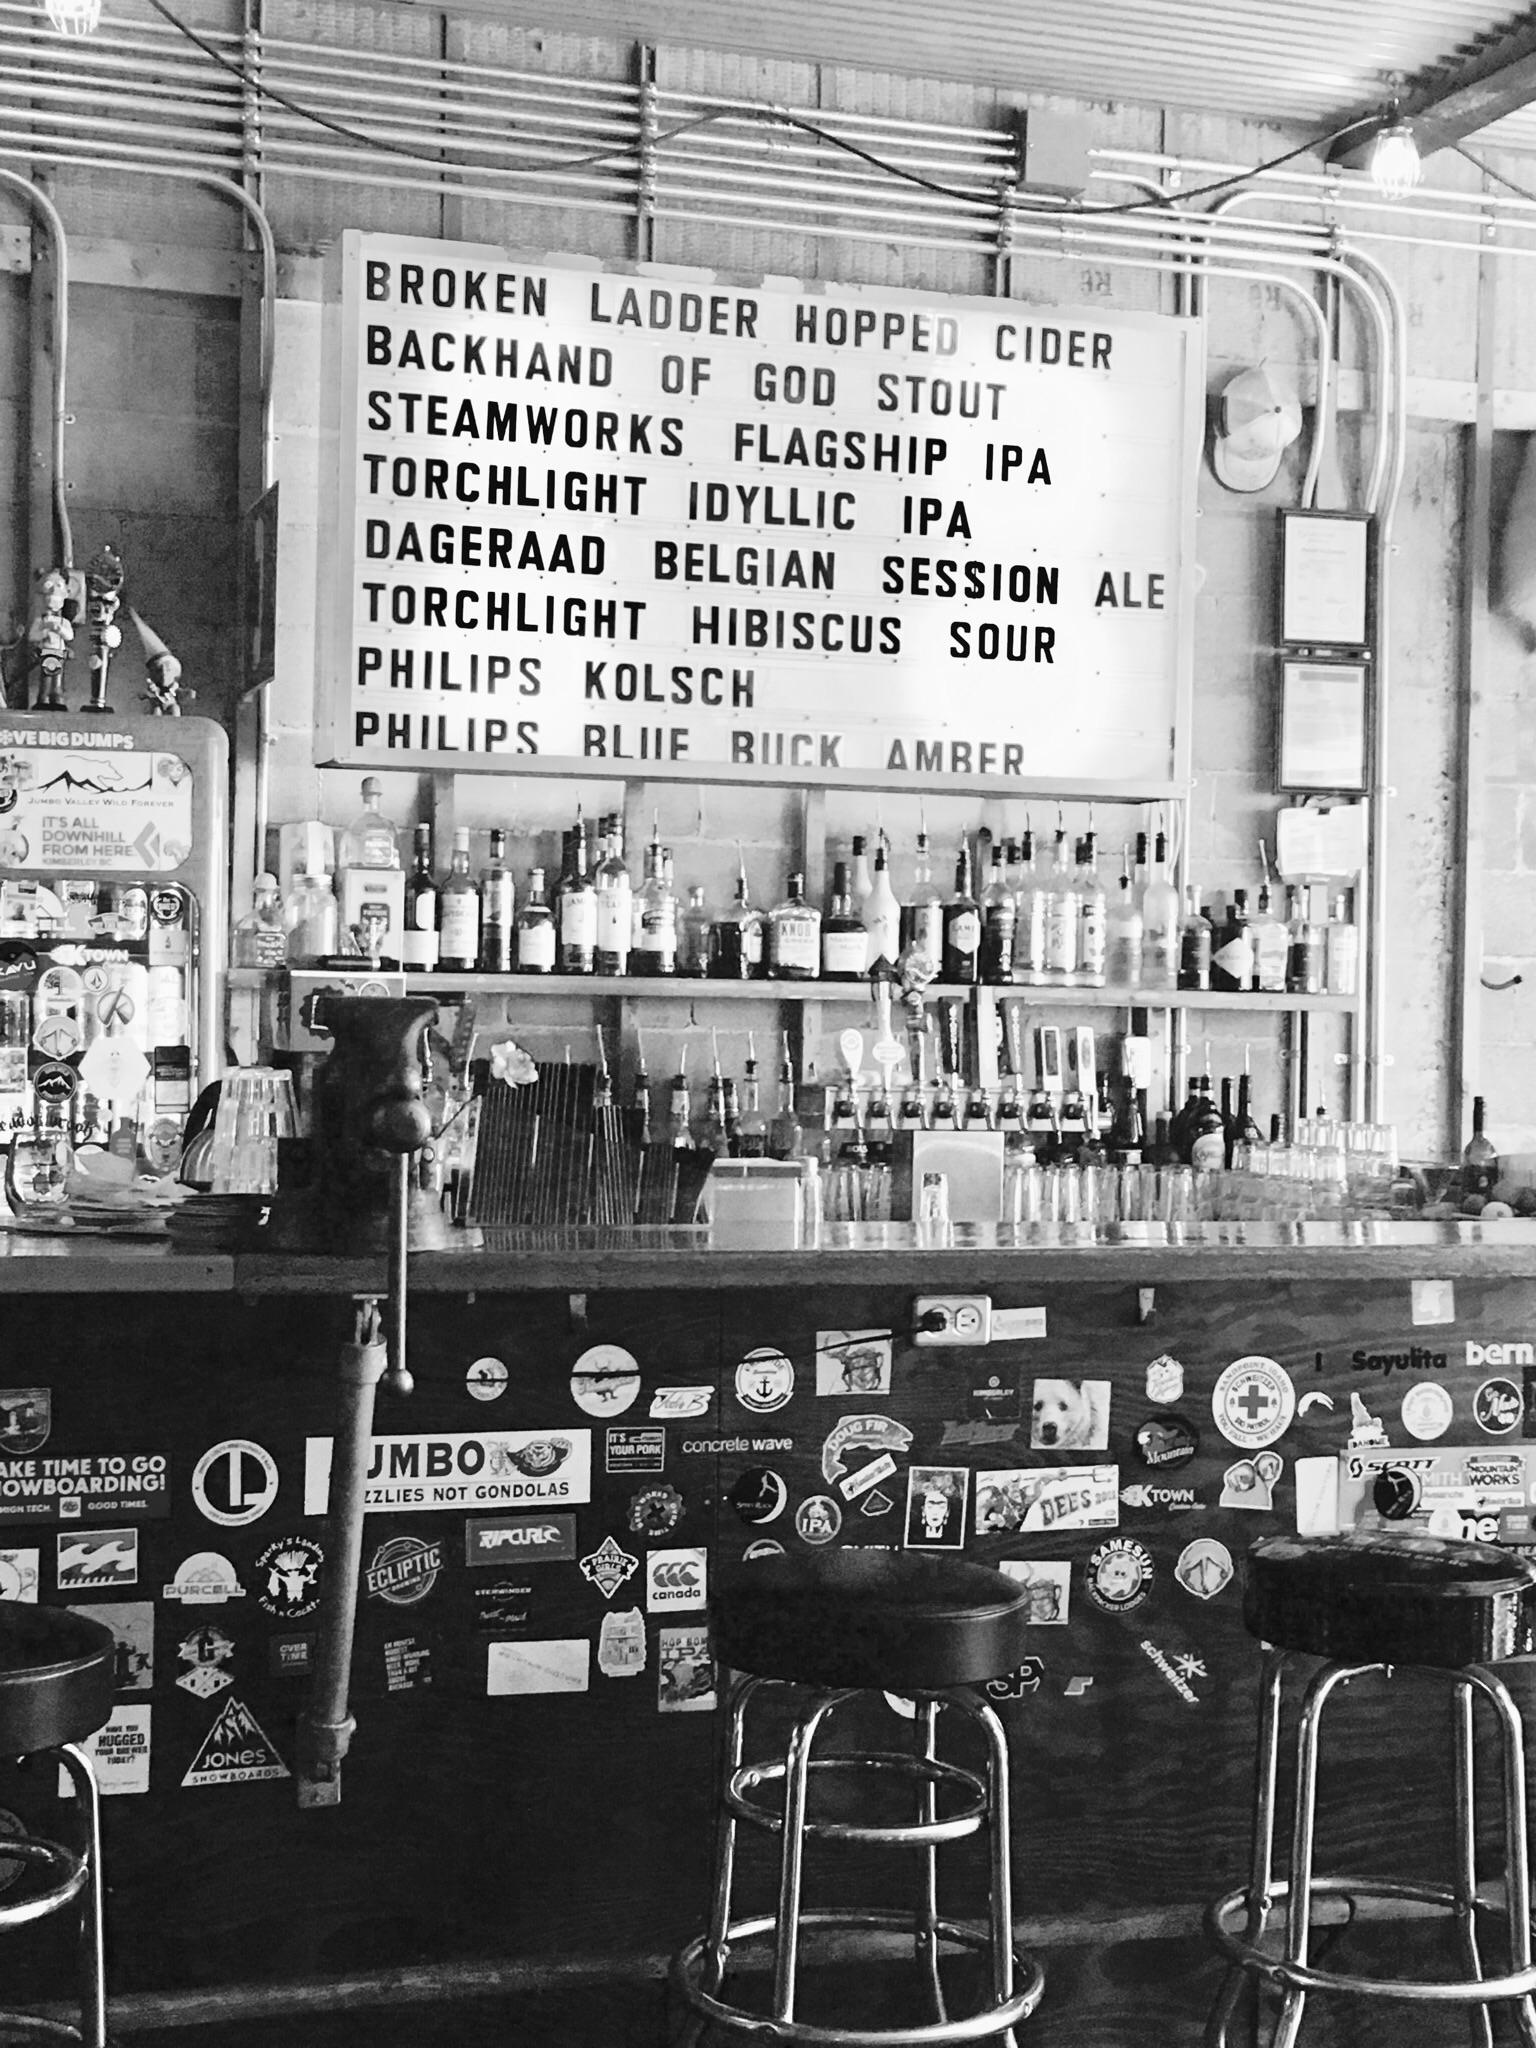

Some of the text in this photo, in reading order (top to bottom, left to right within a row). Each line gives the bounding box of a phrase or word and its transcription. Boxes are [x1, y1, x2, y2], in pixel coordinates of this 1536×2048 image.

[367, 260, 1113, 370] BROKEN LADDER HOPPED CIDER
[367, 325, 1007, 421] BACKHAND OF GOD STOUT
[367, 390, 1052, 485] STEAMWORKS FLAGSHIP IPA
[363, 454, 972, 539] TORCHLIGHT IDYLLIC IPA
[366, 519, 1165, 609] DAGERAAD BELGIAN SESSION ALE
[362, 582, 1056, 664] TORCHLIGHT HIBISCUS SOUR
[358, 646, 755, 708] PHILIPS KOLSCH
[39, 731, 70, 746] BIG
[71, 732, 134, 750] DUMPS
[355, 711, 1025, 776] PHILIPS BLUE BUCK AMBER
[42, 816, 100, 829] IT'S ALL
[42, 830, 126, 843] DOWNHILL
[42, 844, 89, 856] FROM
[1351, 1347, 1447, 1376] Sayulita
[1465, 1340, 1535, 1366] bern
[682, 1436, 793, 1454] concrete wave
[827, 1419, 889, 1451] DOUG FIR
[366, 1439, 486, 1480] UMBO
[609, 1444, 635, 1456] YOUR
[0, 1455, 167, 1479] AKE TIME TO GO
[1421, 1471, 1464, 1486] MITH
[1469, 1473, 1521, 1486] WORKS
[433, 1486, 469, 1502] NOT
[475, 1482, 570, 1500] GONDOLAS
[801, 1518, 834, 1533] IPA
[367, 1547, 442, 1593] ECLIPTIC
[1090, 1538, 1154, 1580] SAMESUN
[164, 1584, 245, 1596] PURCELL
[651, 1587, 701, 1601] canada
[1139, 1639, 1200, 1703] schweitzer
[98, 1732, 145, 1748] HUGGED
[192, 1767, 280, 1783] SNOWBOARDS
